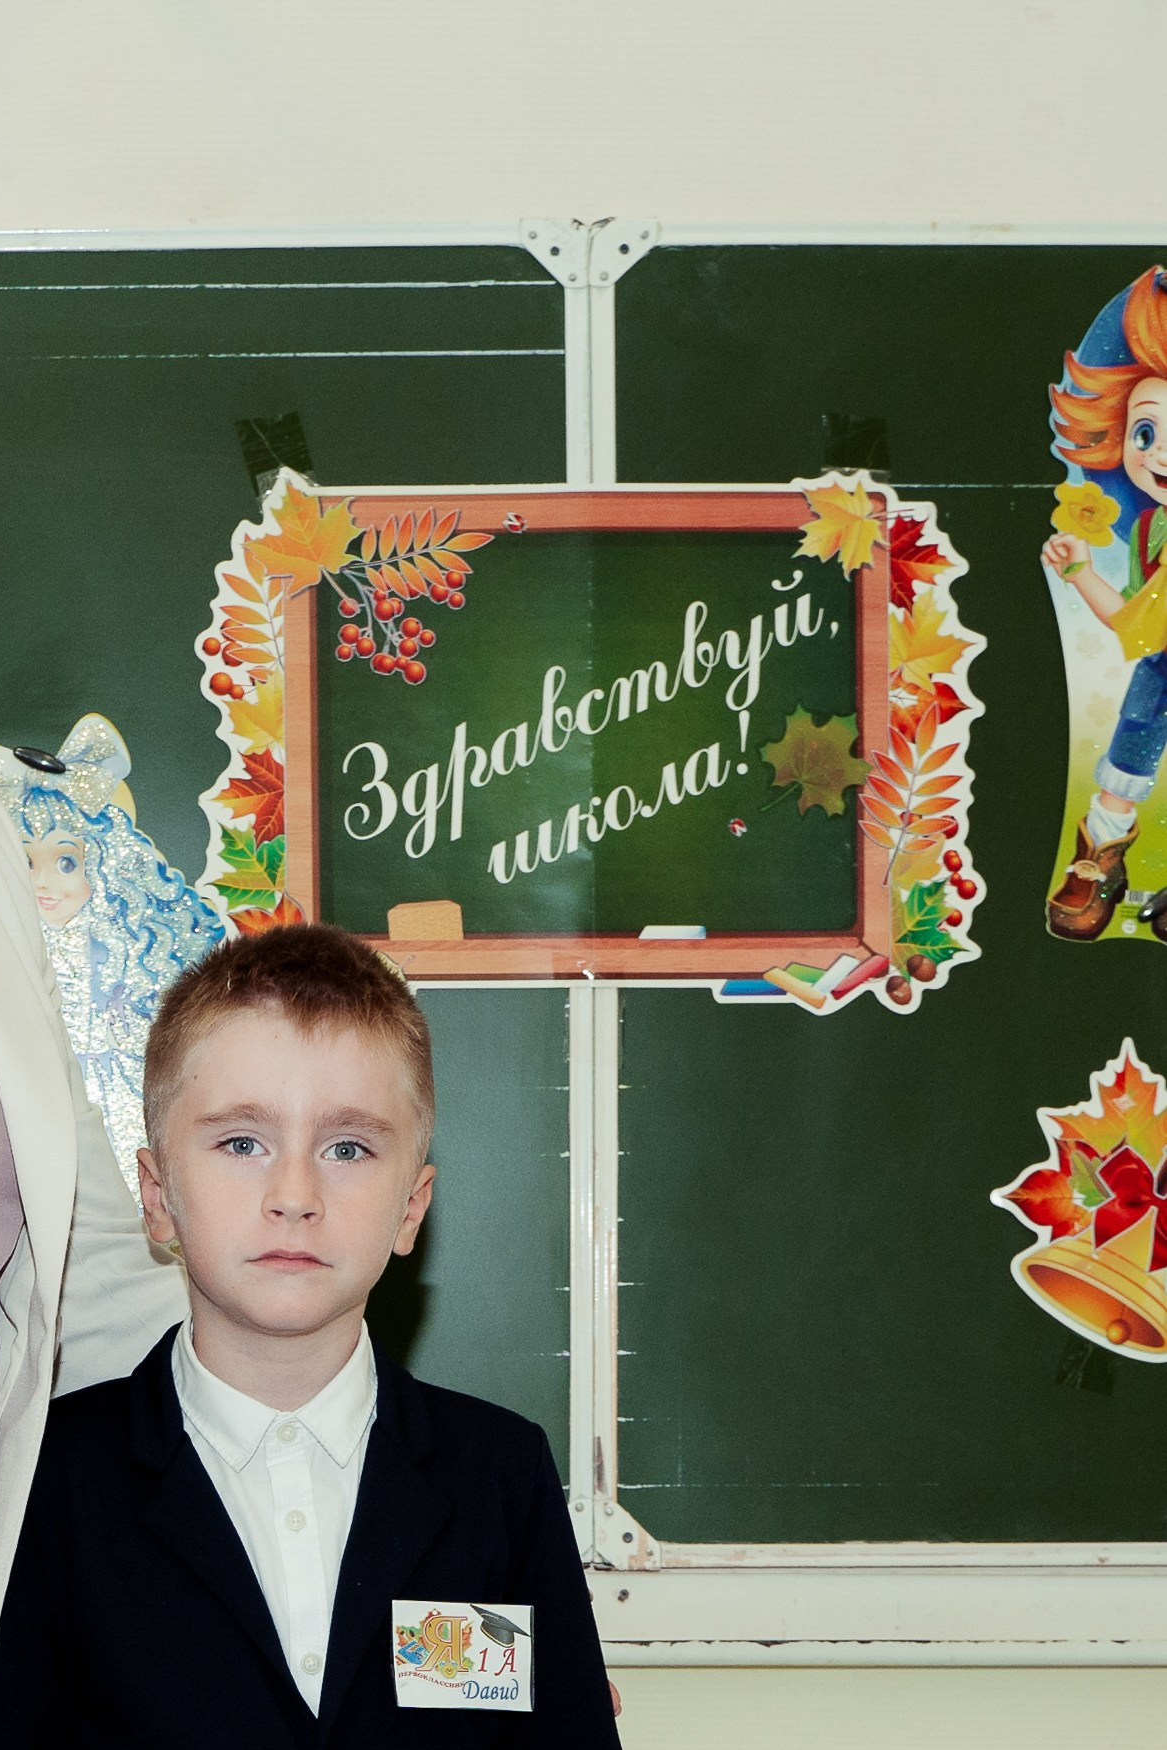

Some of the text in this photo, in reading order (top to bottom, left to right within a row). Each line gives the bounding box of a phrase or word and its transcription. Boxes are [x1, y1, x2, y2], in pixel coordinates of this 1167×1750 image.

[342, 571, 840, 858] Здравствуй,
[487, 710, 751, 885] школа!
[462, 1678, 519, 1700] Давид
[477, 1647, 517, 1676] 1 А
